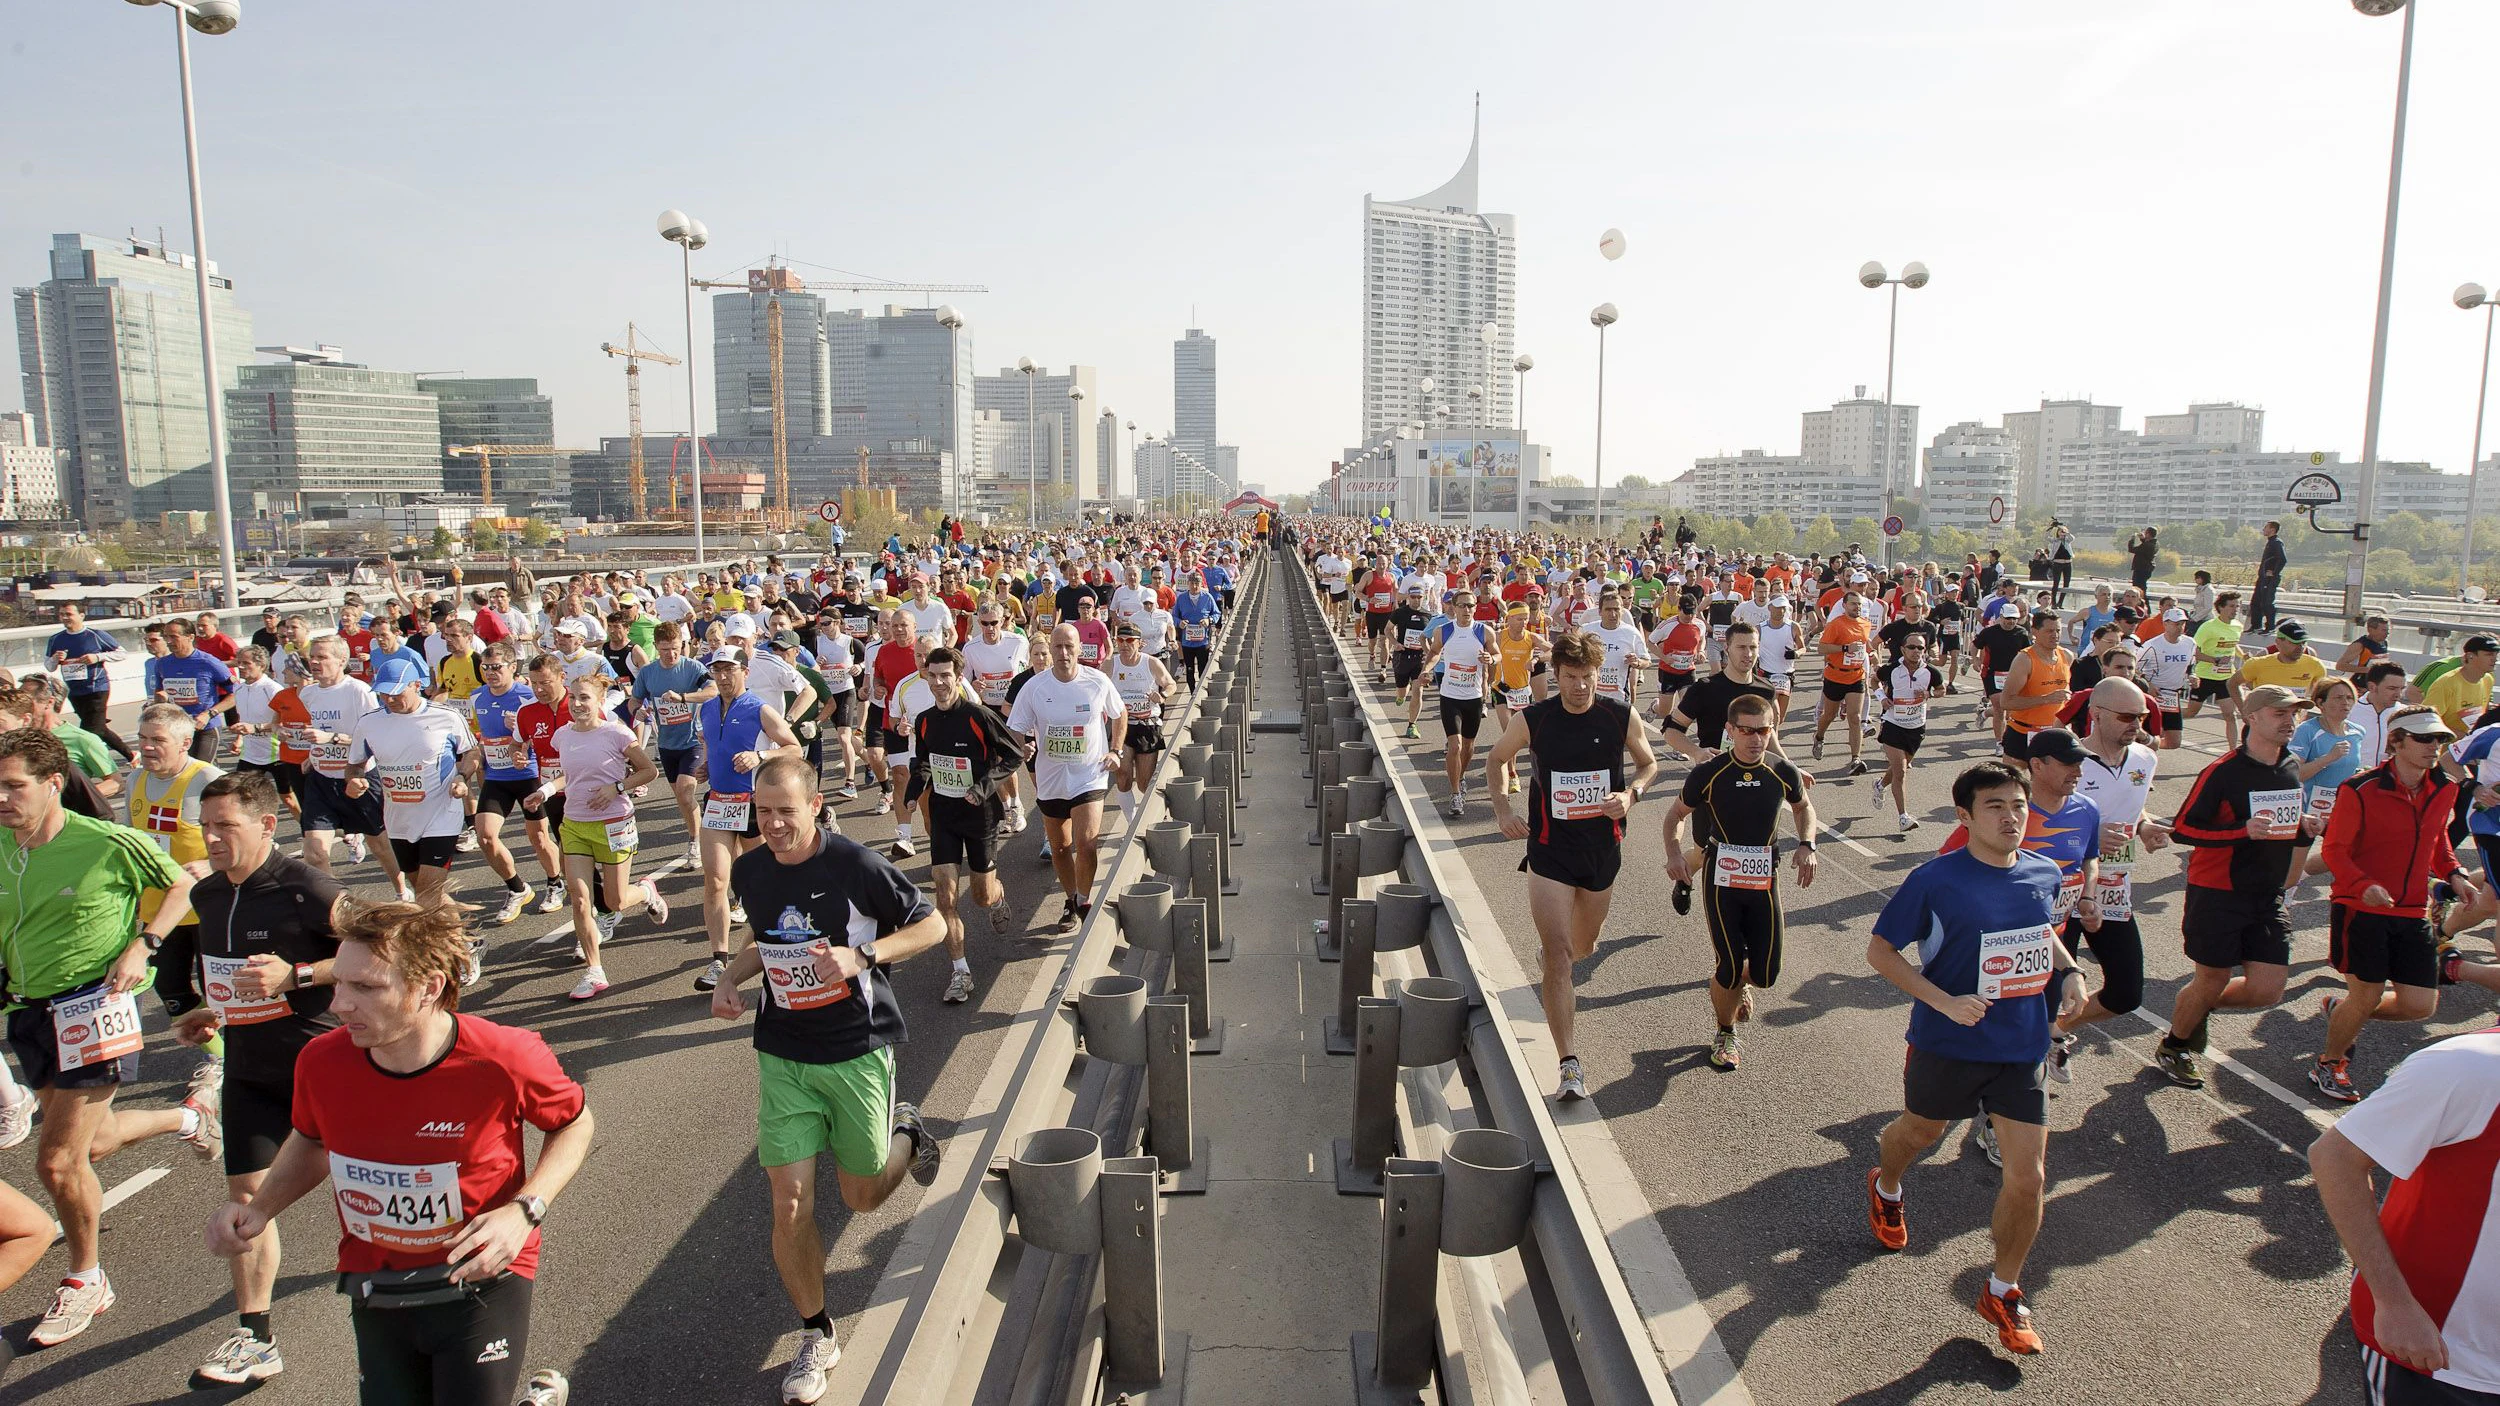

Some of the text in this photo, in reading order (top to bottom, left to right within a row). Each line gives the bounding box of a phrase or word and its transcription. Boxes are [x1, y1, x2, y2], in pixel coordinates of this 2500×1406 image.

[1347, 480, 1399, 492] CINEPLEXX
[2164, 654, 2187, 662] PKE
[1601, 674, 1618, 684] 6055
[178, 688, 195, 697] 4020
[311, 710, 341, 720] SUOMI
[670, 703, 688, 716] 3149
[1048, 739, 1081, 753] 2178-A
[325, 746, 347, 760] 9492
[378, 764, 414, 772] SPARKASSE
[396, 775, 422, 790] 9496
[937, 770, 963, 786] 789-A
[1560, 775, 1591, 785] ERSTE
[1555, 786, 1606, 804] Hervis 9371
[2252, 793, 2295, 803] SPARKASSE
[723, 804, 747, 819] 16241
[708, 820, 733, 829] ERSTE
[1720, 843, 1763, 854] SPARKASSE
[1741, 858, 1769, 875] 6986
[1983, 931, 2041, 948] SPARKASSE
[760, 947, 809, 959] SPARKASS
[1985, 947, 2049, 975] Hervis 2508
[769, 970, 791, 983] Hervis
[208, 985, 231, 998] Hervis
[63, 997, 108, 1019] ERSTE
[61, 1007, 135, 1043] Hervis 1831
[420, 1121, 466, 1132] AMA
[346, 1164, 411, 1188] ERSTE
[341, 1189, 451, 1225] Hervis 4341
[373, 1230, 454, 1246] WIEN ENERGIE
